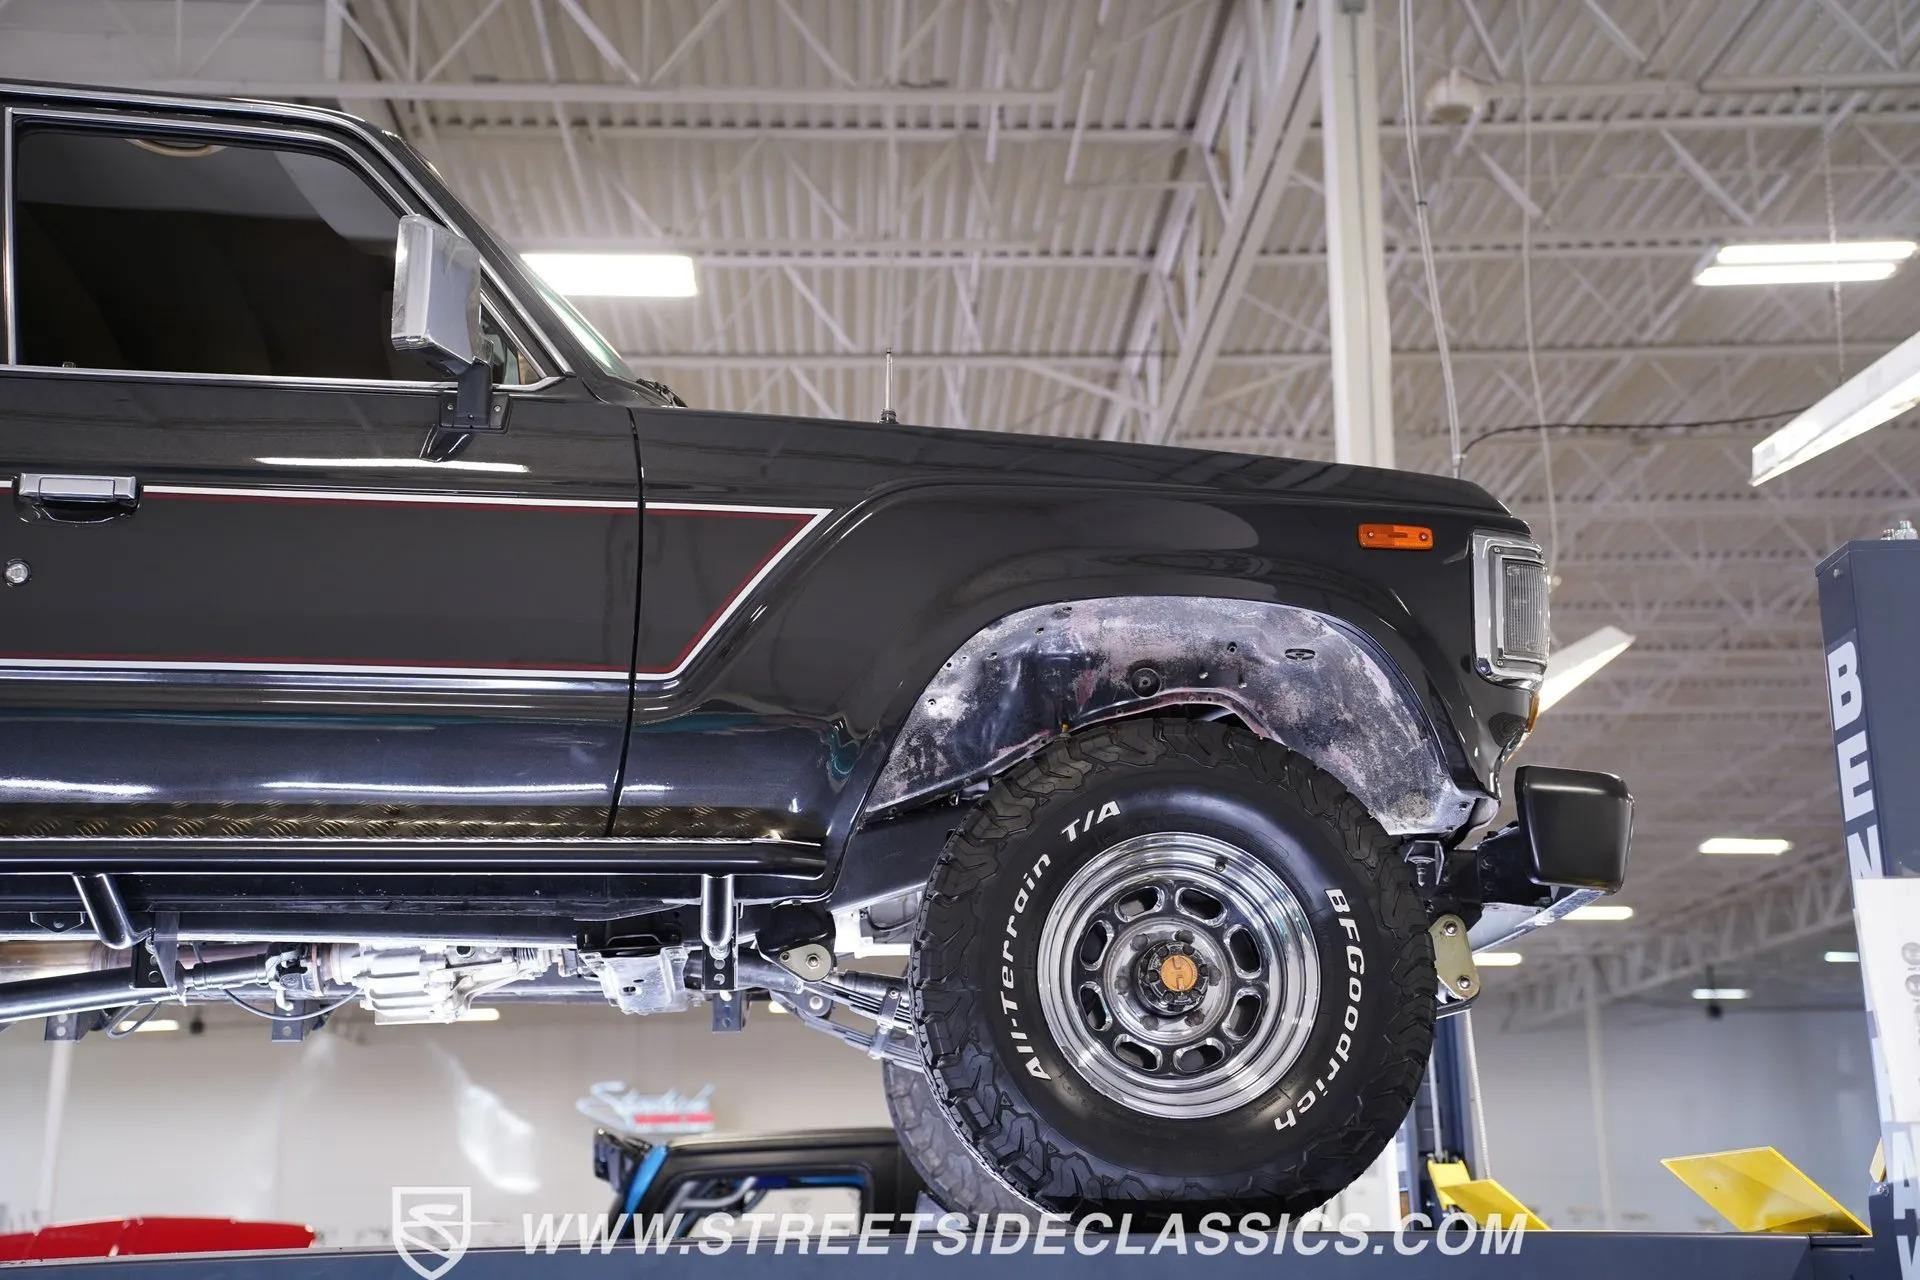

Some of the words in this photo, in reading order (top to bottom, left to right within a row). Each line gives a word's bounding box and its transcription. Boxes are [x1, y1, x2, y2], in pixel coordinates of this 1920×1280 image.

[1001, 853, 1051, 1080] All-Terrain
[1061, 800, 1121, 842] T/A
[1273, 888, 1365, 1131] BFGoodrich
